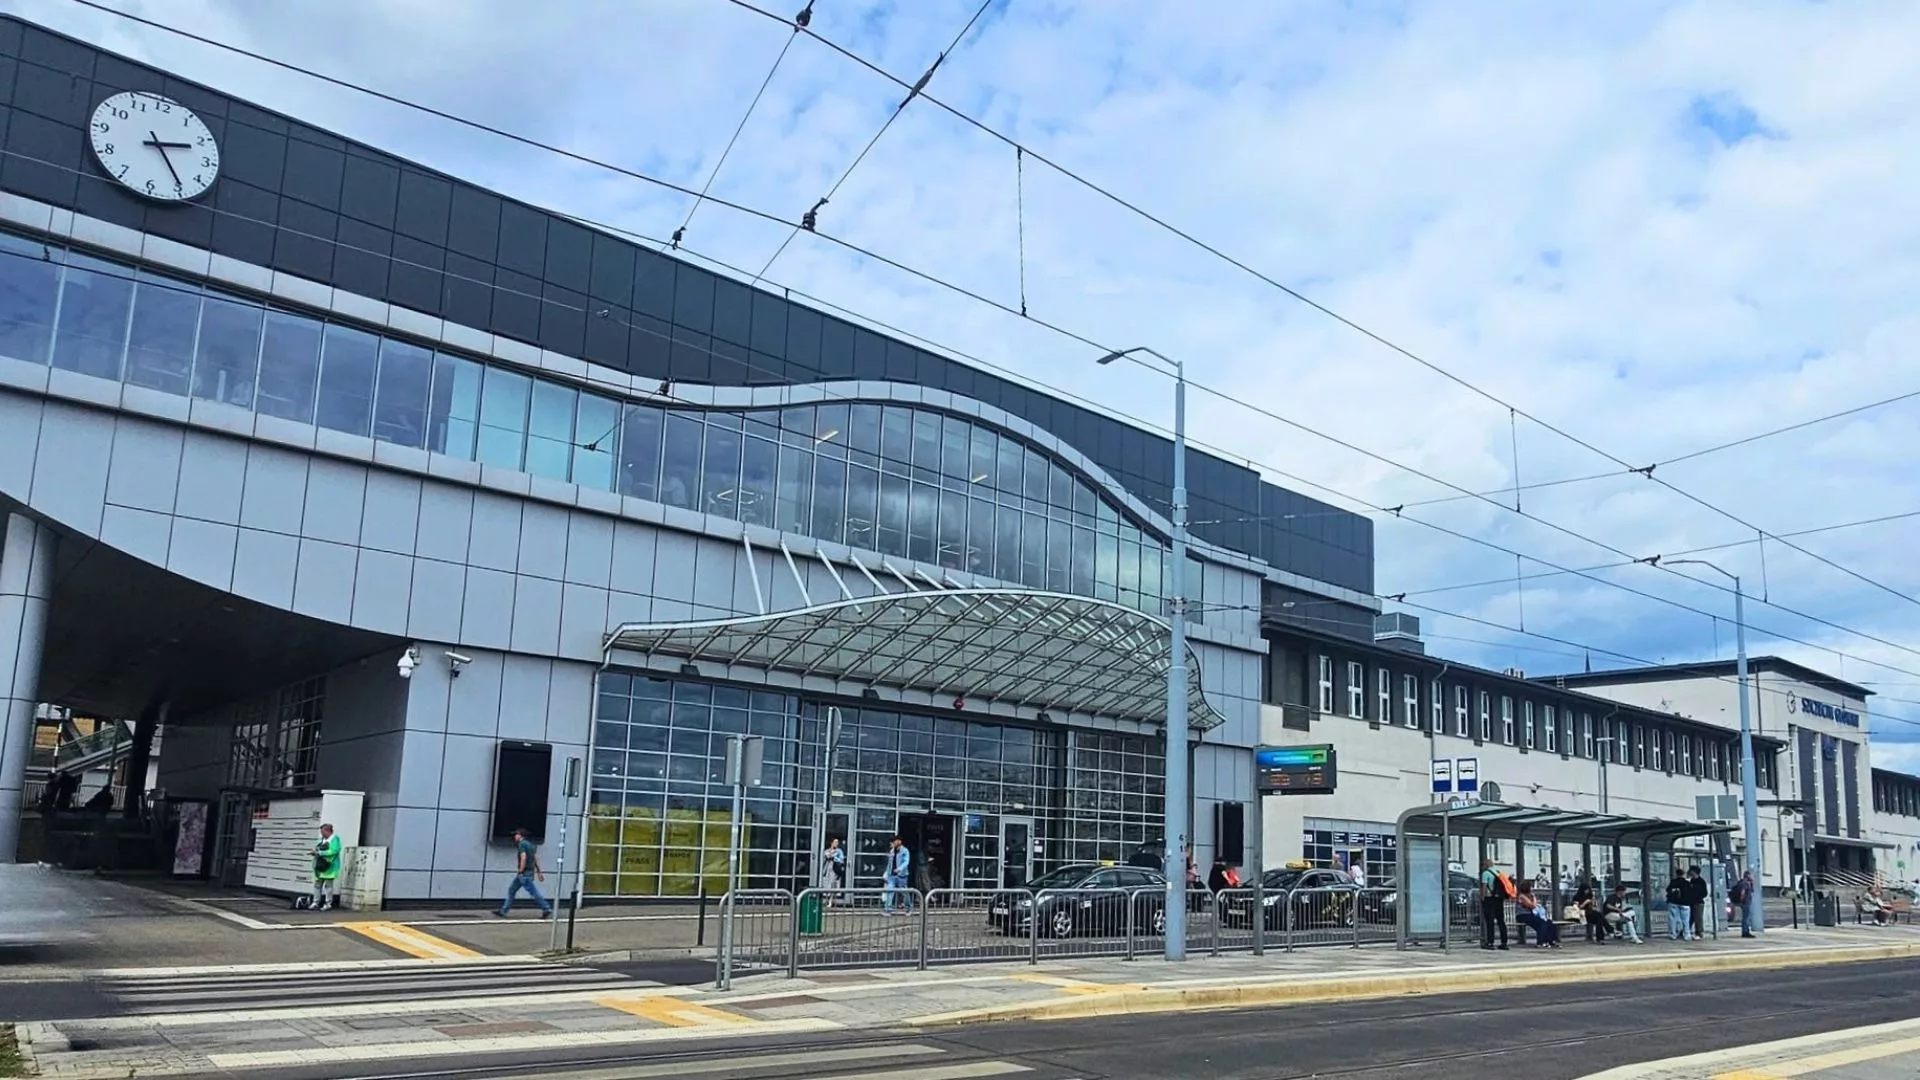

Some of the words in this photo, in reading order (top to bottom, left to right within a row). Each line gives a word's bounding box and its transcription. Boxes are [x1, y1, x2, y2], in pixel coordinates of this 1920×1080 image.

[130, 100, 146, 112] 11
[154, 102, 171, 114] 12
[111, 107, 129, 120] 10
[99, 122, 110, 133] 9
[183, 117, 189, 127] 1
[196, 136, 205, 146] 2
[104, 143, 115, 155] 8
[201, 156, 211, 168] 3
[121, 164, 130, 175] 7
[192, 174, 202, 183] 4
[145, 179, 155, 191] 6
[173, 182, 183, 193] 5
